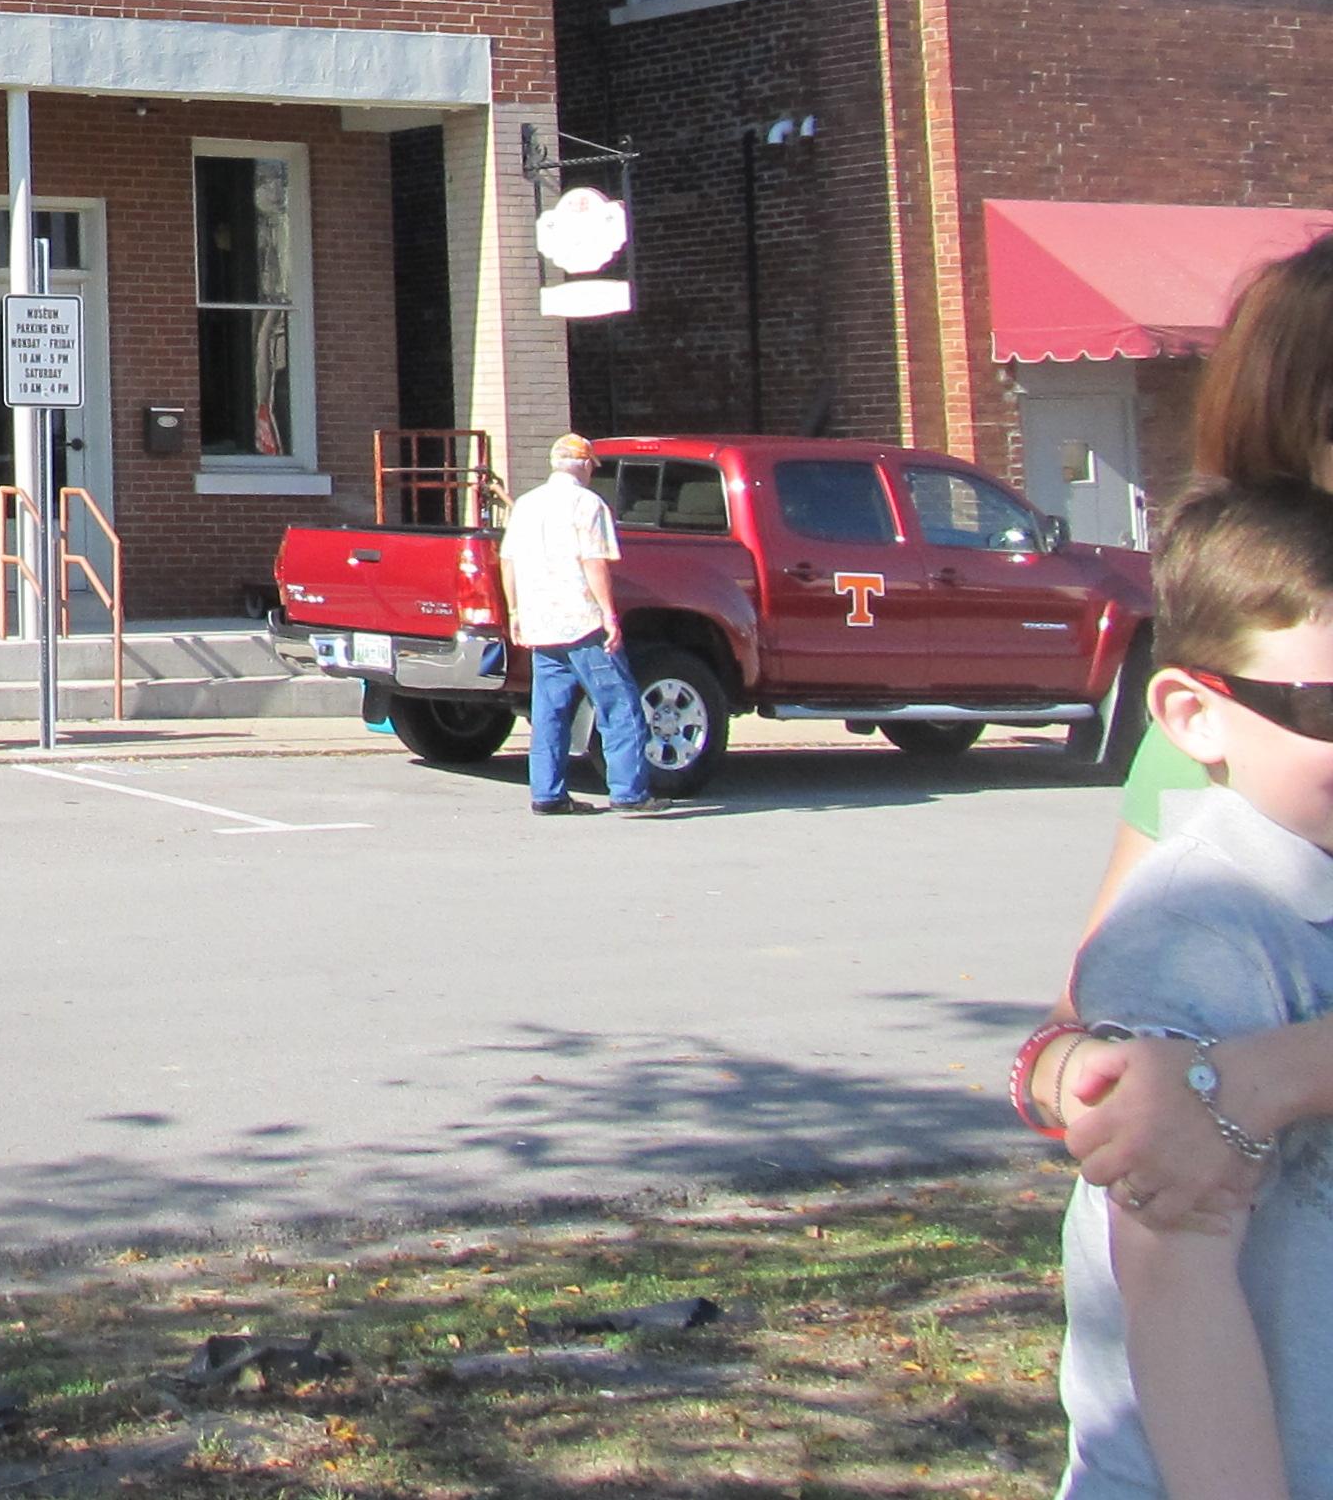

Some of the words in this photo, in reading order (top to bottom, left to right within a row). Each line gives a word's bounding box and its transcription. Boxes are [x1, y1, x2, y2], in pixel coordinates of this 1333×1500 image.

[27, 308, 59, 319] MUSEUM
[16, 323, 48, 334] PARKING
[51, 324, 69, 334] ONLY
[11, 338, 41, 348] MONDAY
[49, 339, 75, 349] FRIDAY
[19, 353, 28, 363] 10
[30, 353, 41, 363] AM
[58, 353, 69, 364] PM
[25, 368, 62, 378] SATURDAY
[19, 383, 28, 393] 10
[30, 383, 41, 393] AM
[50, 383, 55, 393] 4
[58, 383, 69, 393] PM
[834, 572, 885, 626] T
